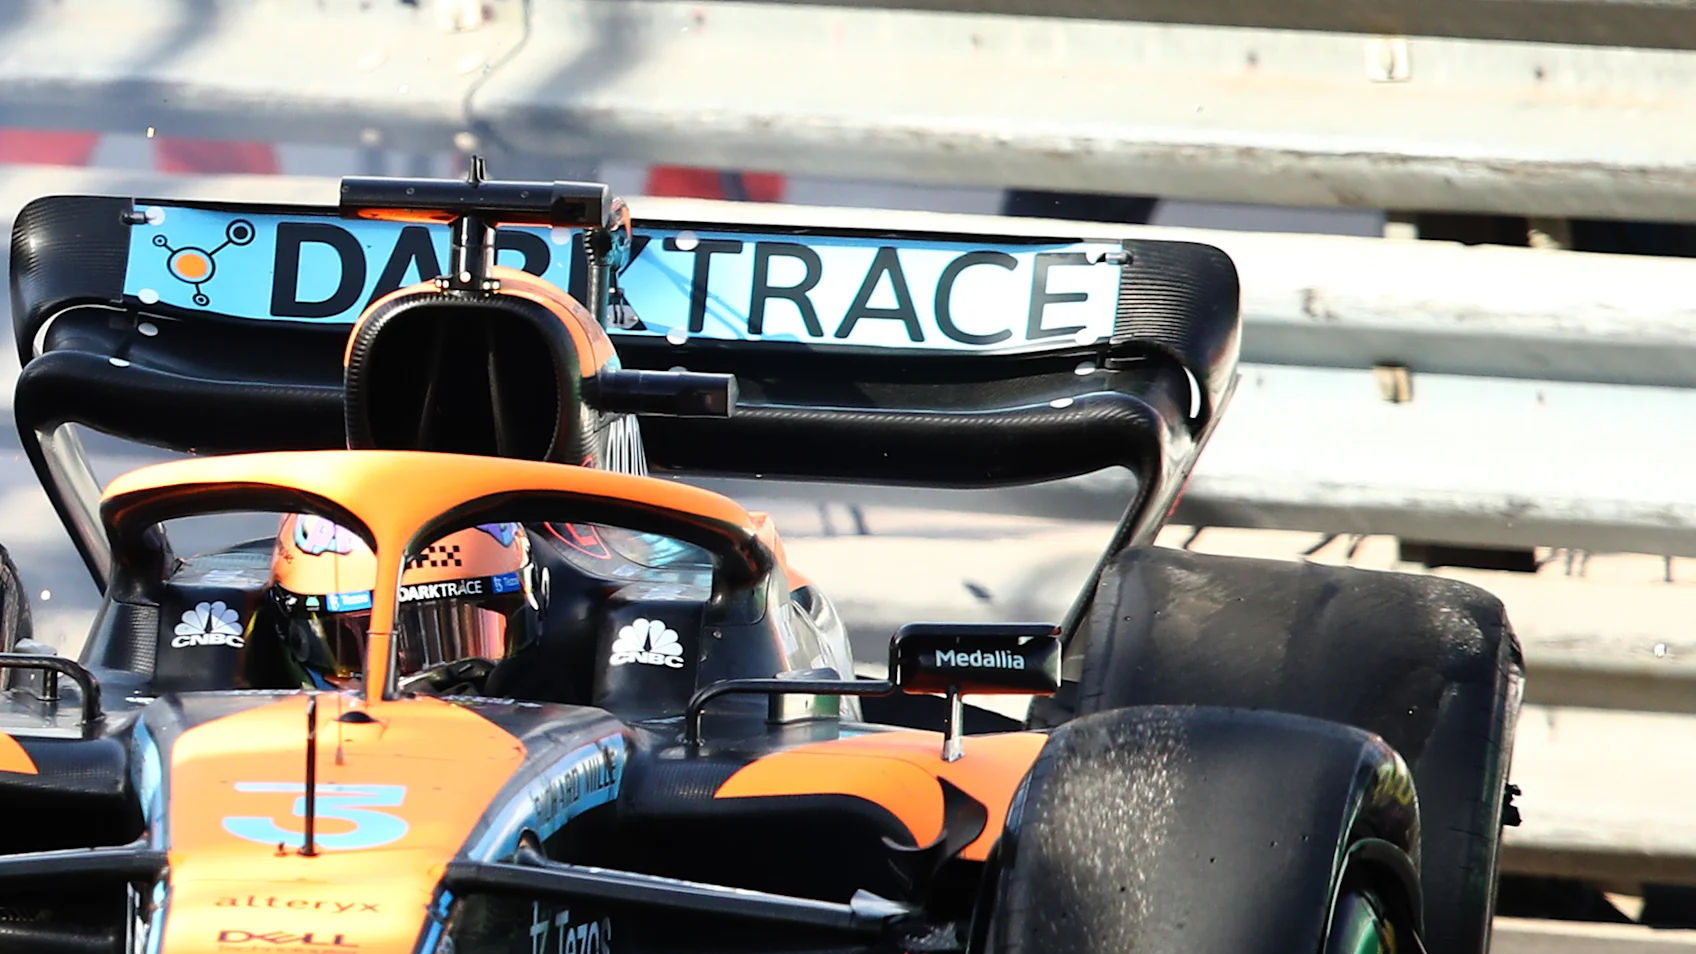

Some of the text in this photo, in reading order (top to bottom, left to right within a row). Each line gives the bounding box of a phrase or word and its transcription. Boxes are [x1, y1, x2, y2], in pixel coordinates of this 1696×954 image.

[399, 580, 483, 602] DARKTRACE
[171, 633, 245, 648] CNBC
[609, 651, 685, 669] CNBC
[935, 649, 1025, 670] Medallia
[221, 781, 410, 850] 3
[215, 895, 380, 913] alteryx
[217, 930, 360, 947] DELL
